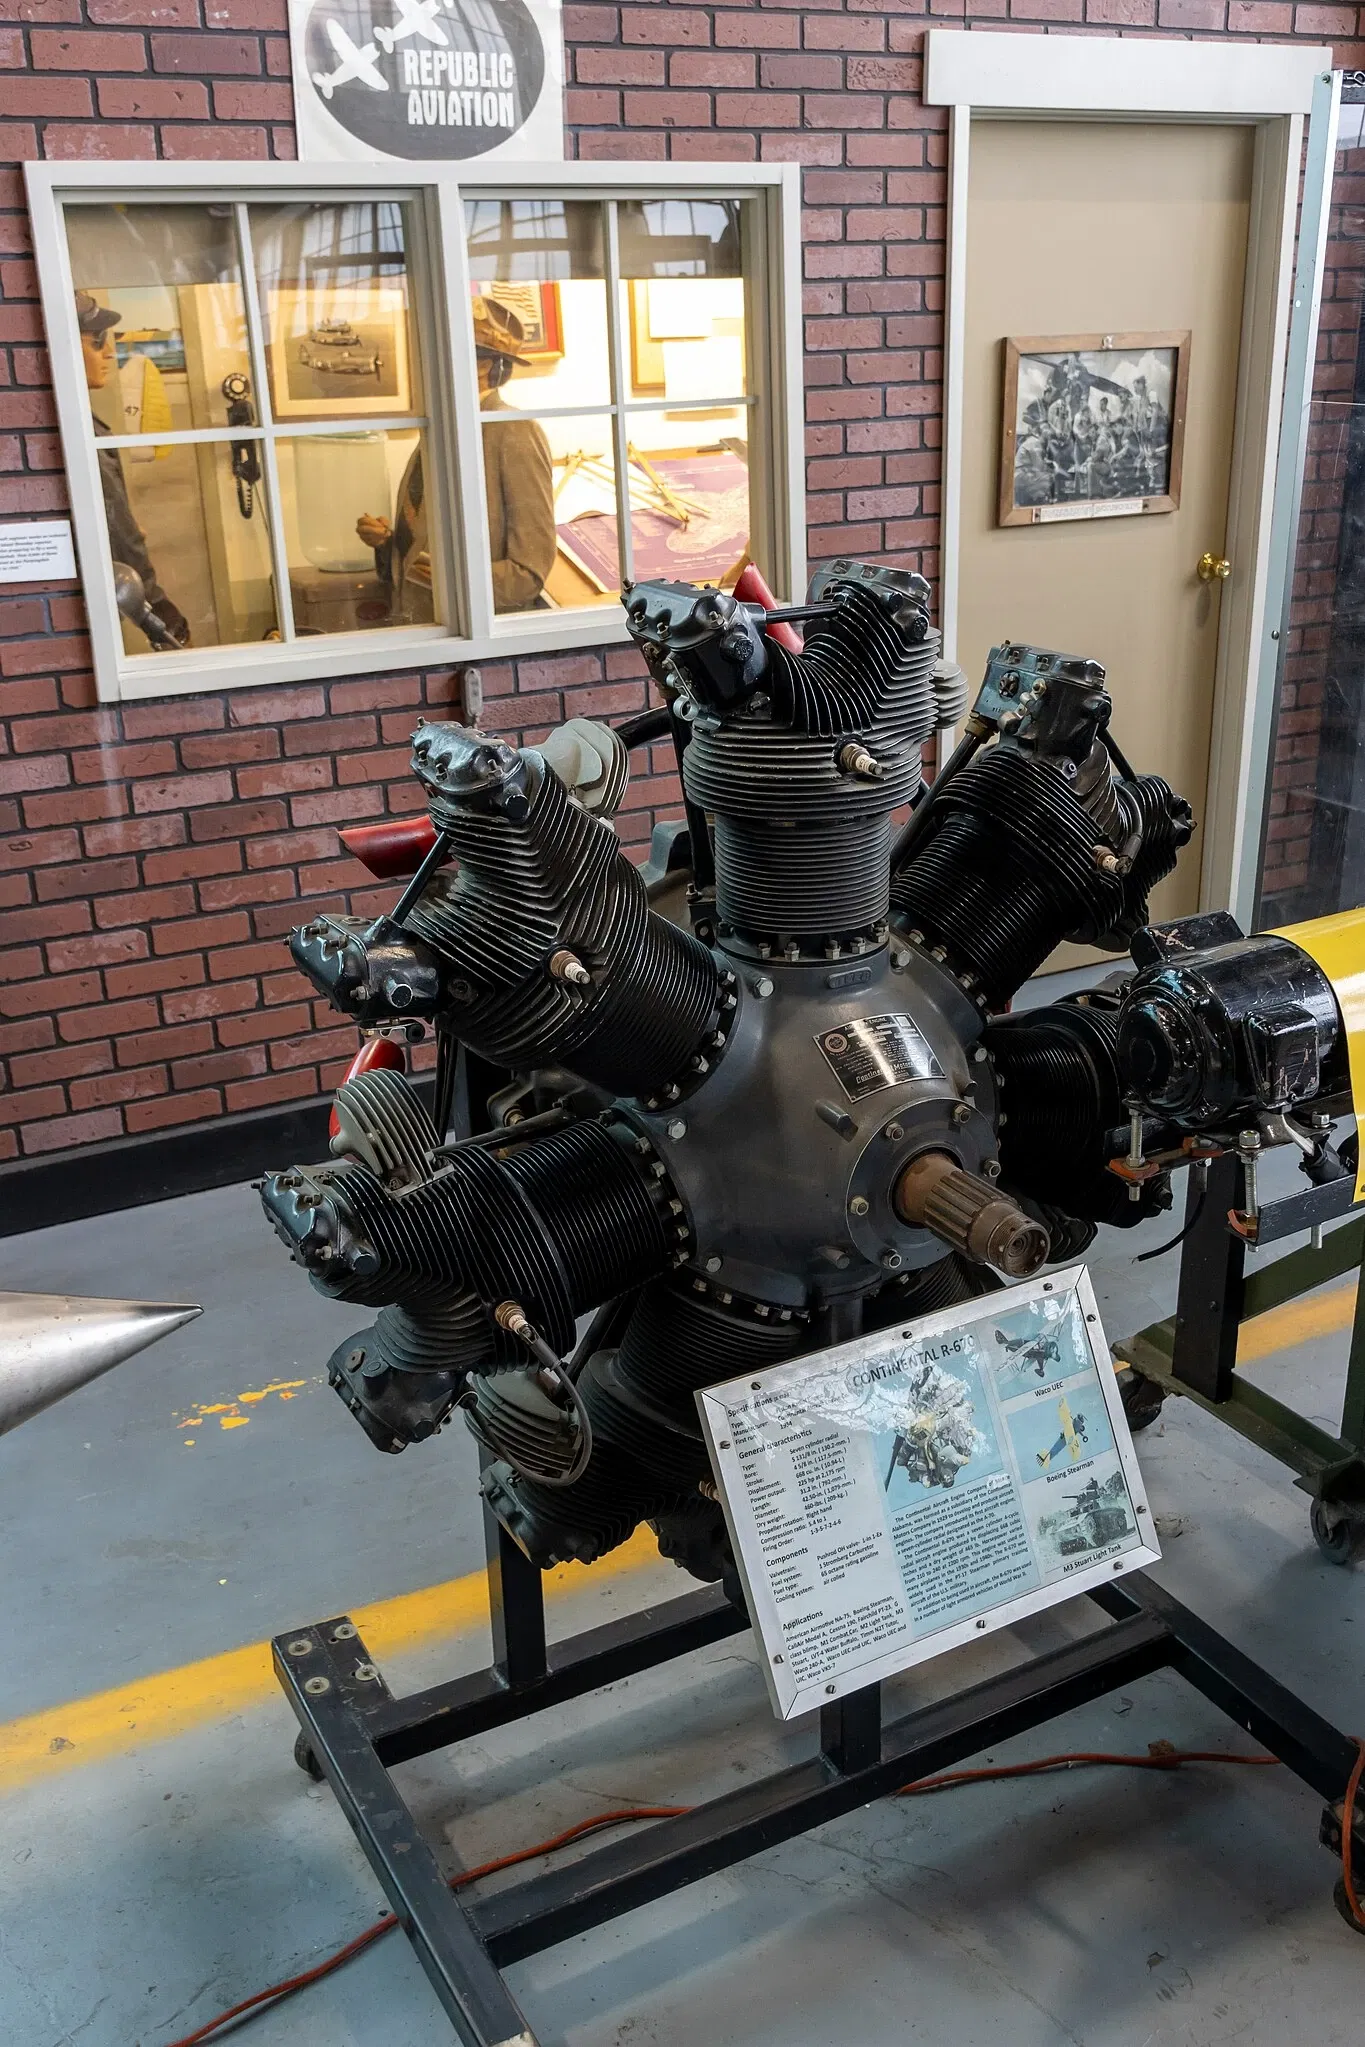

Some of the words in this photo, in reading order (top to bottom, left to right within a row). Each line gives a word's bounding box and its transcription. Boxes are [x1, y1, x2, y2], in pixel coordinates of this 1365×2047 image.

[404, 49, 513, 88] REPUBLIC
[408, 90, 514, 127] AVIATION
[852, 1348, 939, 1387] CONTINENTAL
[1034, 1387, 1051, 1397] Waco
[1051, 1381, 1063, 1391] UEC
[735, 1437, 747, 1445] First
[789, 1445, 804, 1454] Seven
[804, 1438, 824, 1449] cylinder
[824, 1432, 839, 1441] radial
[738, 1444, 765, 1459] General
[742, 1463, 755, 1471] Type:
[743, 1471, 758, 1479] Bore:
[835, 1465, 845, 1473] rpm
[1046, 1471, 1067, 1483] Boeing
[1067, 1460, 1094, 1475] Stearman
[745, 1478, 764, 1487] Stroke:
[747, 1480, 781, 1495] Displacment:
[750, 1494, 766, 1503] Power
[767, 1487, 786, 1497] output:
[752, 1502, 771, 1512] Length:
[754, 1507, 779, 1520] Diameter:
[805, 1510, 819, 1518] Right
[819, 1505, 832, 1513] hand
[758, 1524, 781, 1536] Propeller
[782, 1517, 804, 1527] rotation:
[766, 1514, 785, 1524] weight:
[760, 1529, 793, 1544] Compression
[793, 1524, 806, 1532] ratio:
[762, 1544, 777, 1552] Firing
[777, 1537, 793, 1547] Order:
[766, 1547, 808, 1567] Components
[816, 1549, 837, 1561] Pushrod
[822, 1554, 848, 1567] Stromberg
[848, 1543, 874, 1557] Carburetor
[827, 1564, 844, 1574] octane
[845, 1558, 859, 1567] rating
[859, 1550, 878, 1562] gasoline
[1063, 1563, 1073, 1572] M3
[1074, 1556, 1092, 1568] Stuart
[1092, 1550, 1107, 1560] Light
[1107, 1544, 1121, 1553] Tank
[769, 1566, 796, 1578] Valvetrain:
[771, 1579, 782, 1587] Fuel
[783, 1573, 802, 1582] system:
[830, 1572, 845, 1582] colled
[773, 1587, 784, 1595] Fuel
[785, 1583, 797, 1591] type:
[775, 1593, 795, 1603] Cooling
[795, 1586, 813, 1596] system:
[782, 1610, 823, 1630] Applications
[785, 1630, 809, 1642] American
[810, 1620, 834, 1633] Airmotive
[834, 1612, 851, 1622] NA-75,
[852, 1605, 870, 1615] Boeing
[869, 1595, 894, 1608] Stearman,
[789, 1651, 802, 1659] class
[868, 1617, 880, 1626] Light
[804, 1633, 821, 1643] Model
[829, 1624, 846, 1634] Cessna
[810, 1650, 824, 1659] LVT-4
[824, 1644, 839, 1653] Water
[860, 1629, 874, 1638] Timm
[874, 1624, 884, 1632] N2T
[793, 1666, 808, 1675] Waco
[826, 1652, 840, 1661] Waco
[840, 1647, 851, 1656] UEC
[851, 1643, 861, 1651] and
[861, 1639, 871, 1647] UIC,
[872, 1633, 886, 1642] Waco
[886, 1627, 896, 1636] UEC
[897, 1624, 906, 1632] and
[806, 1670, 821, 1679] Waco
